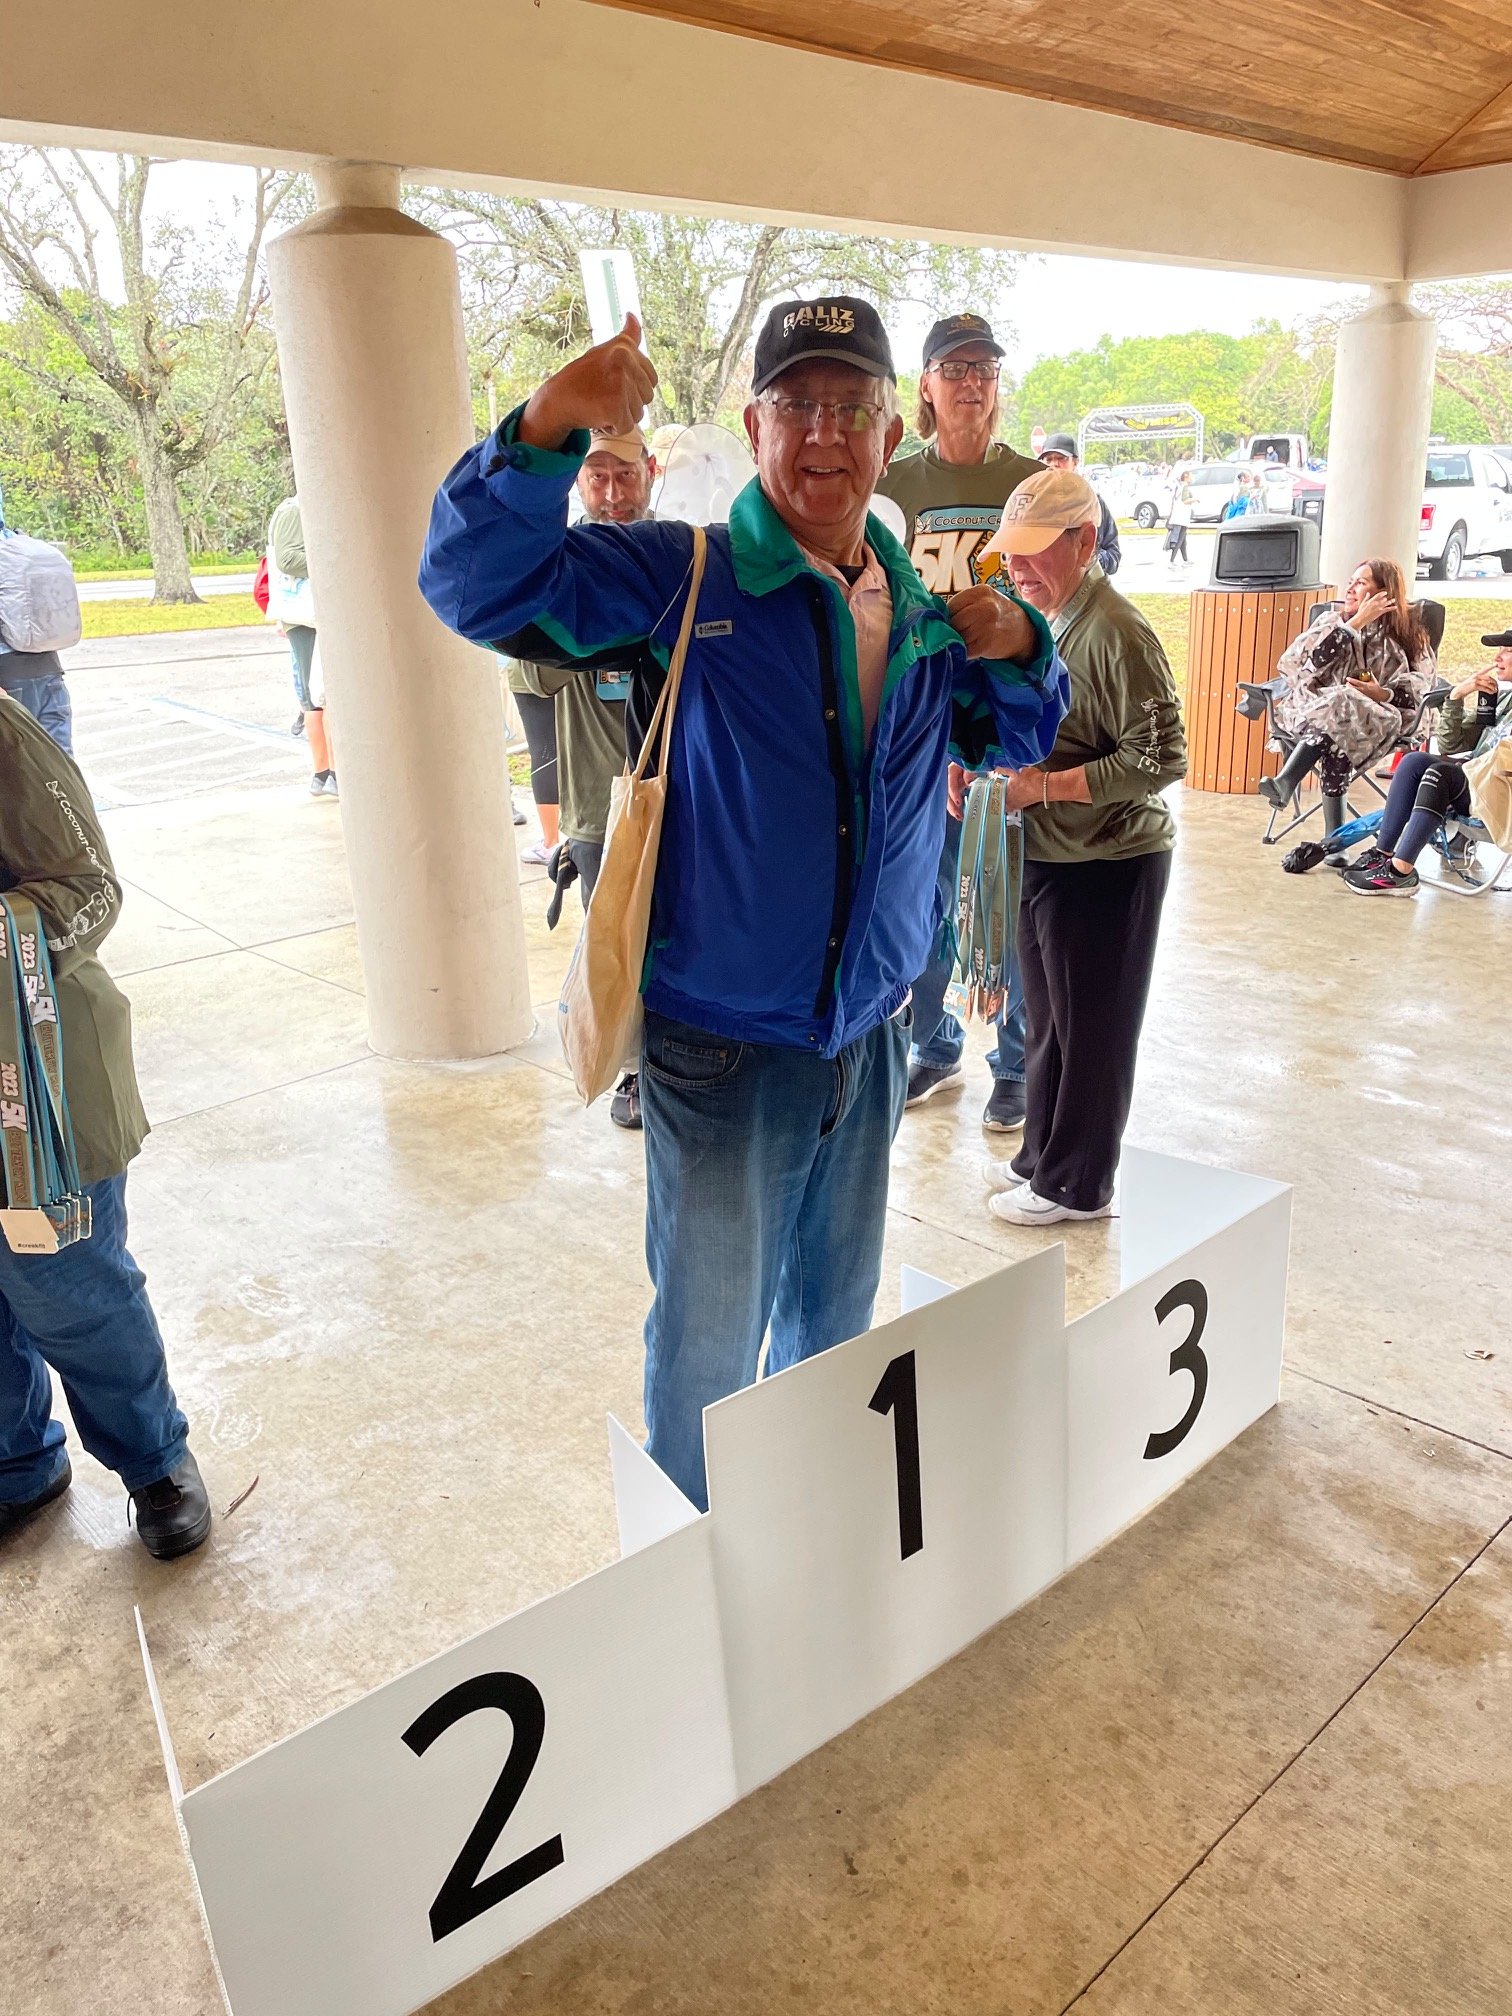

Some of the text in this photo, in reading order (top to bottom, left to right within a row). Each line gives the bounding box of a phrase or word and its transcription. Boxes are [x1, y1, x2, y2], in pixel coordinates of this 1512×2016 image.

[783, 317, 855, 338] CYCLING
[784, 305, 854, 329] GALIZ
[1008, 493, 1035, 520] F
[910, 531, 984, 594] 5K
[961, 875, 970, 898] 2023
[20, 933, 39, 1006] 2023 5K
[33, 996, 57, 1026] 5K
[1, 1063, 19, 1097] 2023
[1, 1101, 28, 1131] 5K
[1143, 1280, 1207, 1459] 3
[868, 1350, 923, 1560] 1
[401, 1672, 564, 1943] 2
